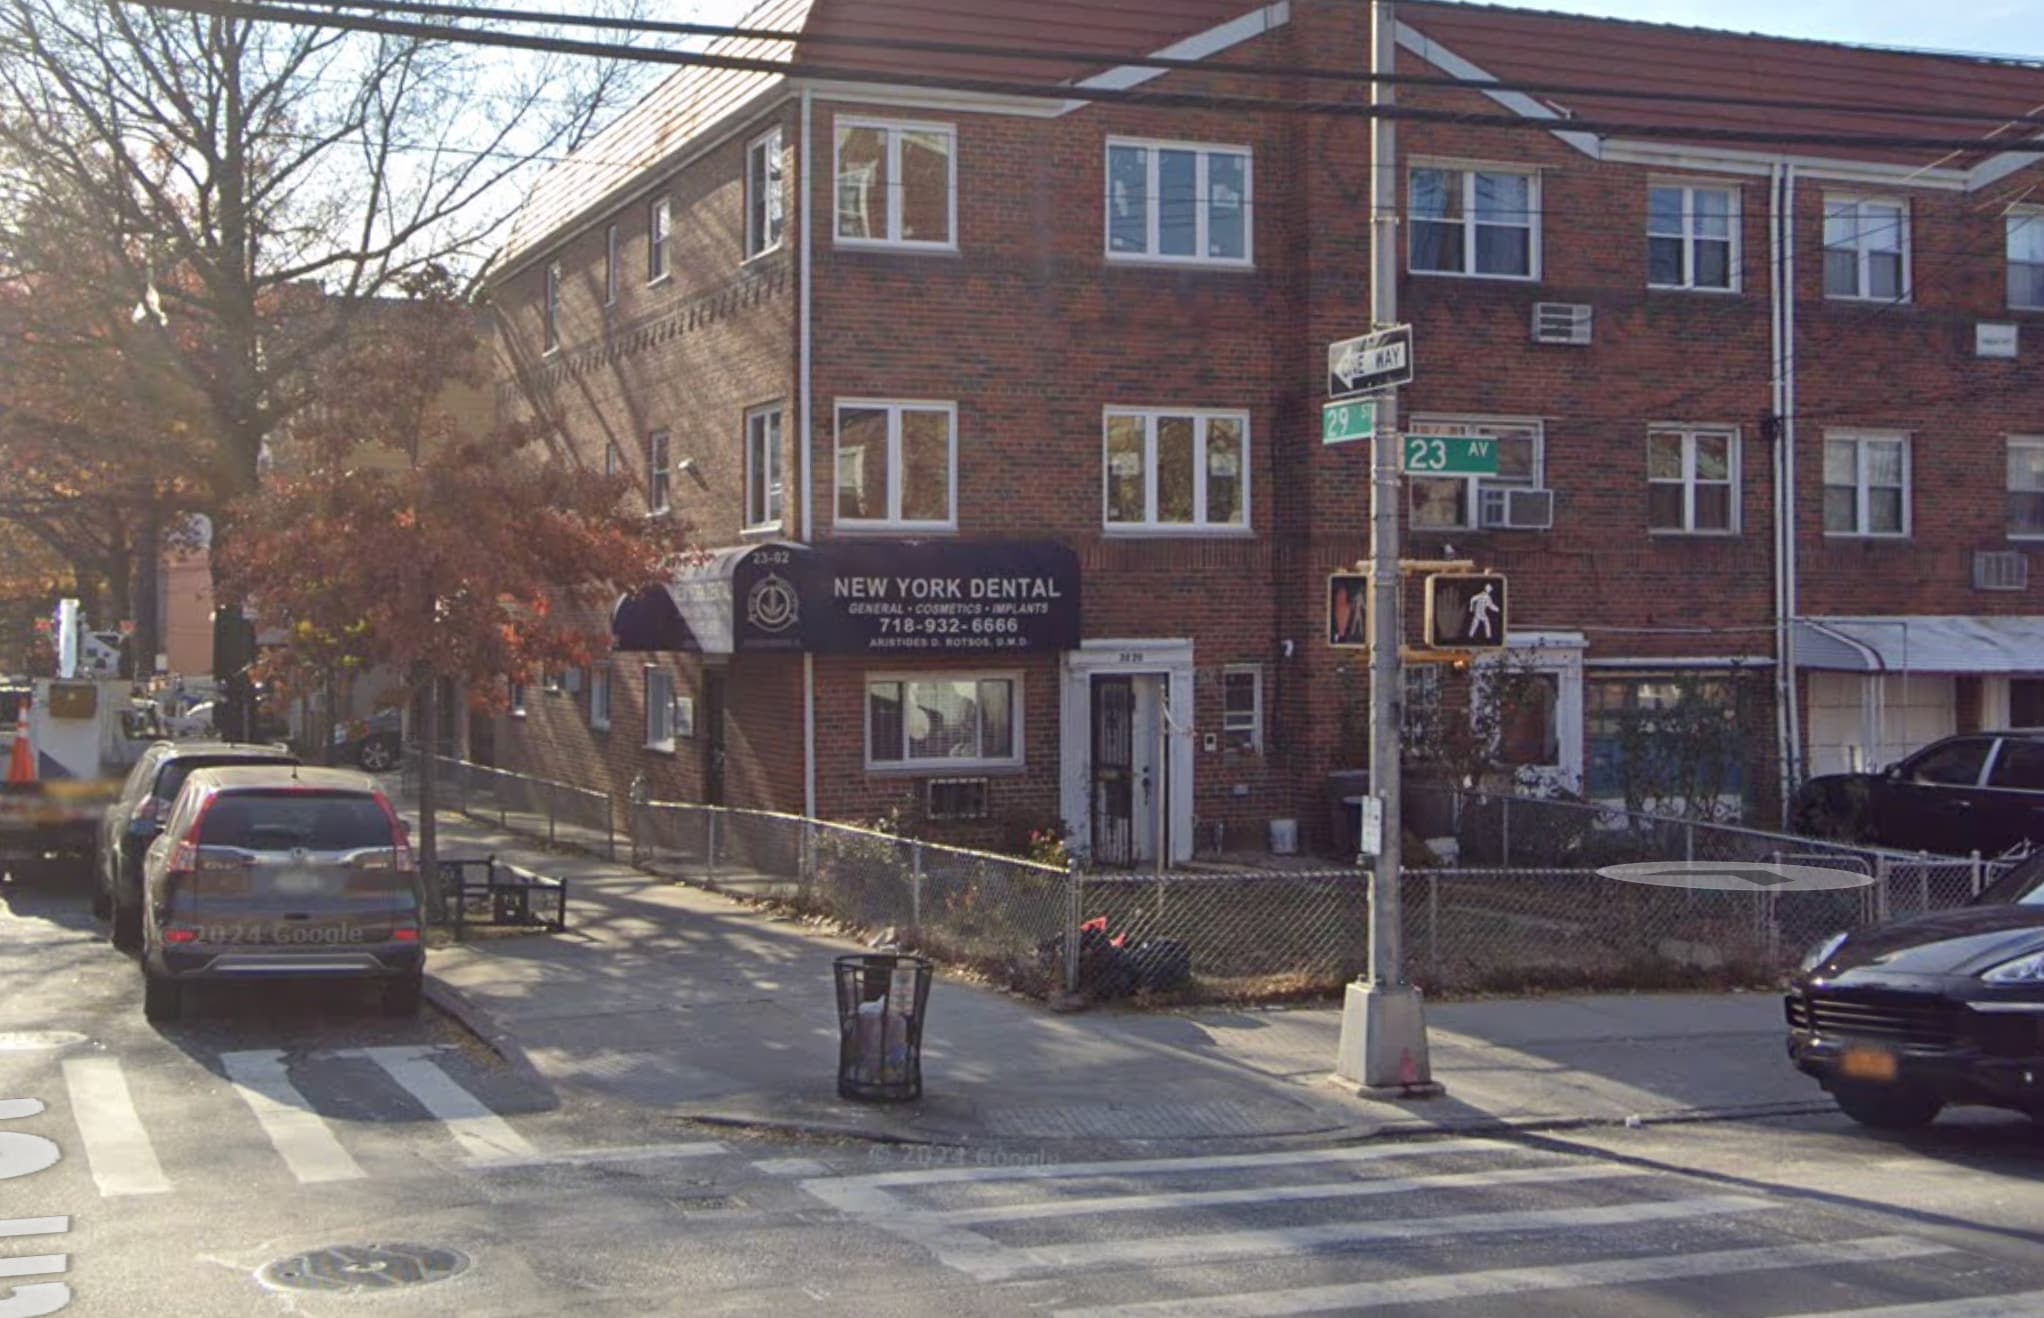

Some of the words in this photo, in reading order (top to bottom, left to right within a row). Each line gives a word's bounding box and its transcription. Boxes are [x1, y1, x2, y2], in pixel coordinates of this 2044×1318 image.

[1375, 346, 1402, 370] WAY
[1326, 407, 1350, 437] 29
[1409, 438, 1447, 470] 23
[1467, 441, 1490, 457] AV
[833, 577, 889, 598] NEW
[896, 577, 962, 598] YORK
[969, 577, 1062, 598] DENTAL
[848, 602, 904, 615] GENERAL
[914, 602, 983, 615] COSMETICS
[991, 602, 1049, 615] IMPLANTS
[879, 617, 1019, 634] 718-932-6666
